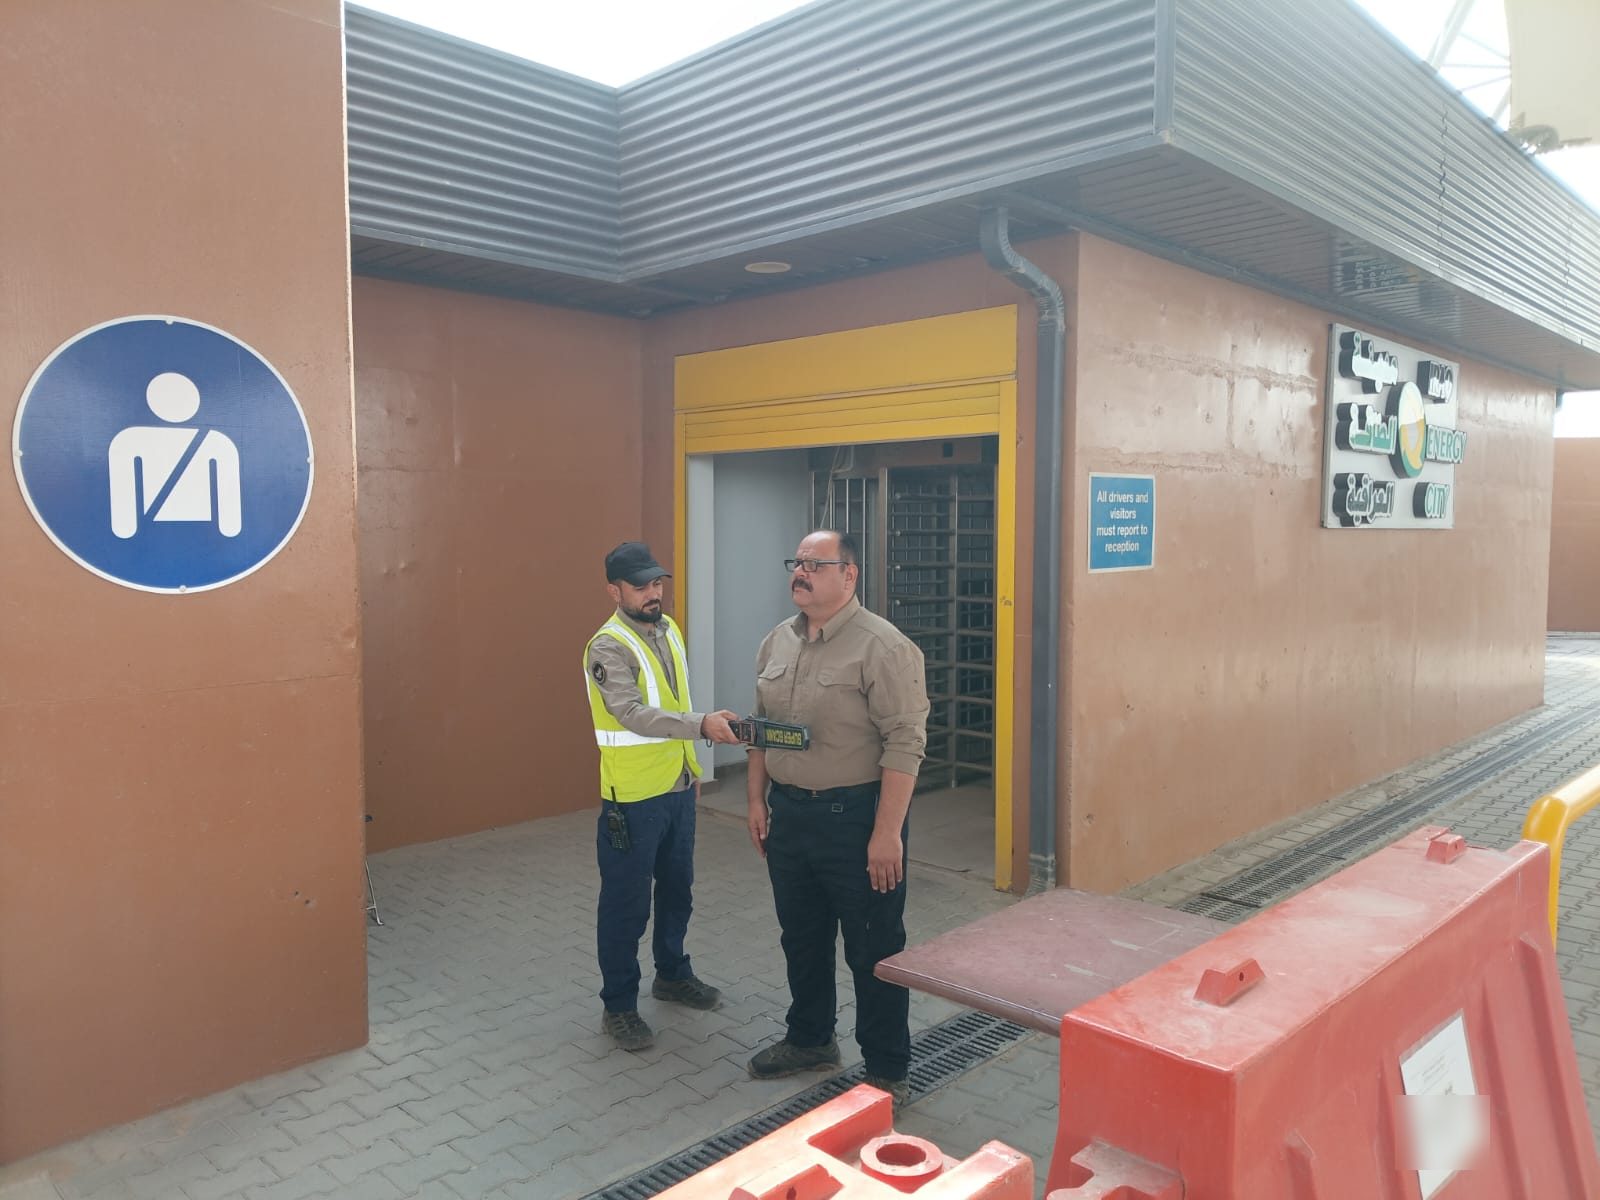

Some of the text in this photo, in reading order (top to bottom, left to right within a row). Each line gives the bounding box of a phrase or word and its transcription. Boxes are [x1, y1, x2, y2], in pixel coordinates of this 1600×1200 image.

[1349, 403, 1397, 454] الطاقة
[1426, 425, 1467, 463] ENERGY
[1096, 490, 1149, 504] All drivers and
[1346, 473, 1395, 527] العراقية
[1424, 483, 1450, 519] CITY
[1109, 507, 1137, 520] visitors
[1096, 523, 1148, 538] must report to
[1104, 540, 1140, 555] reception
